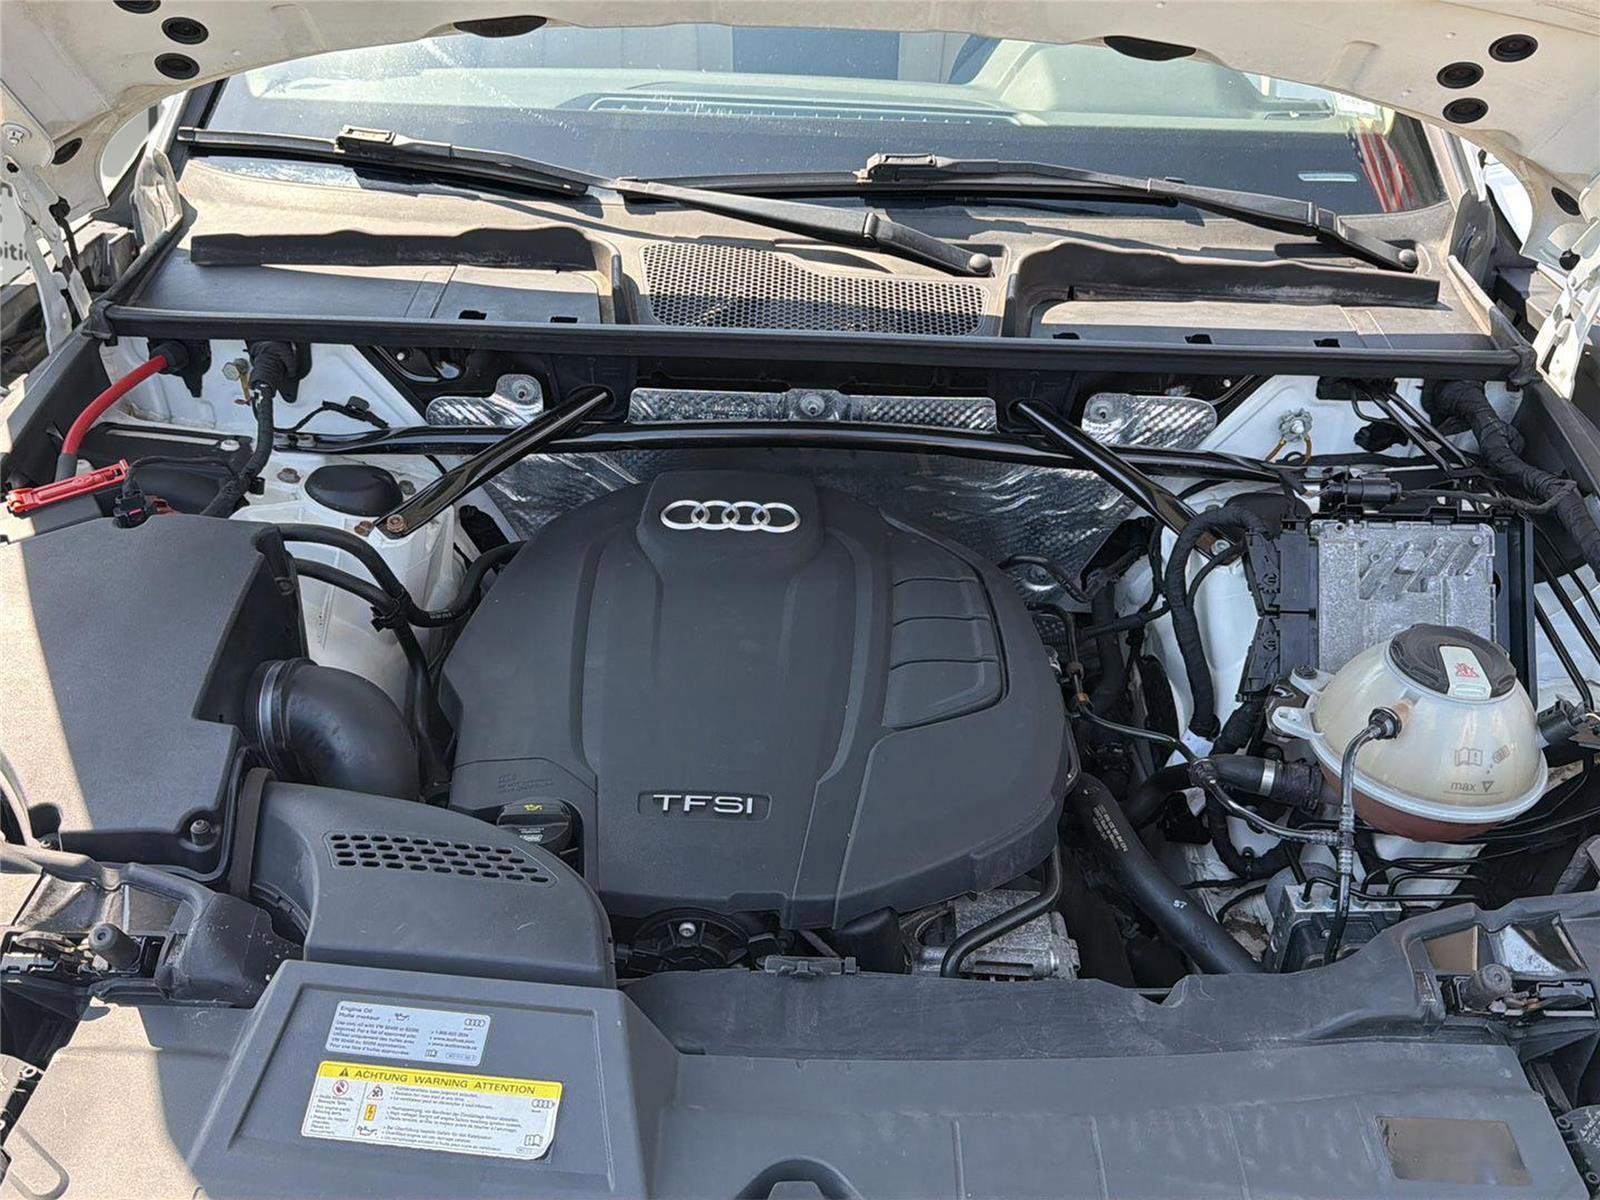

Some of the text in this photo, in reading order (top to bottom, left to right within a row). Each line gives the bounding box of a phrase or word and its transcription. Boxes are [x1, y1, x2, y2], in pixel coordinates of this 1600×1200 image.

[1450, 782, 1477, 792] max
[653, 794, 753, 814] TFSI
[355, 1070, 408, 1083] ACHTUNG
[414, 1075, 468, 1088] WARNING
[474, 1081, 536, 1094] ATTENTION
